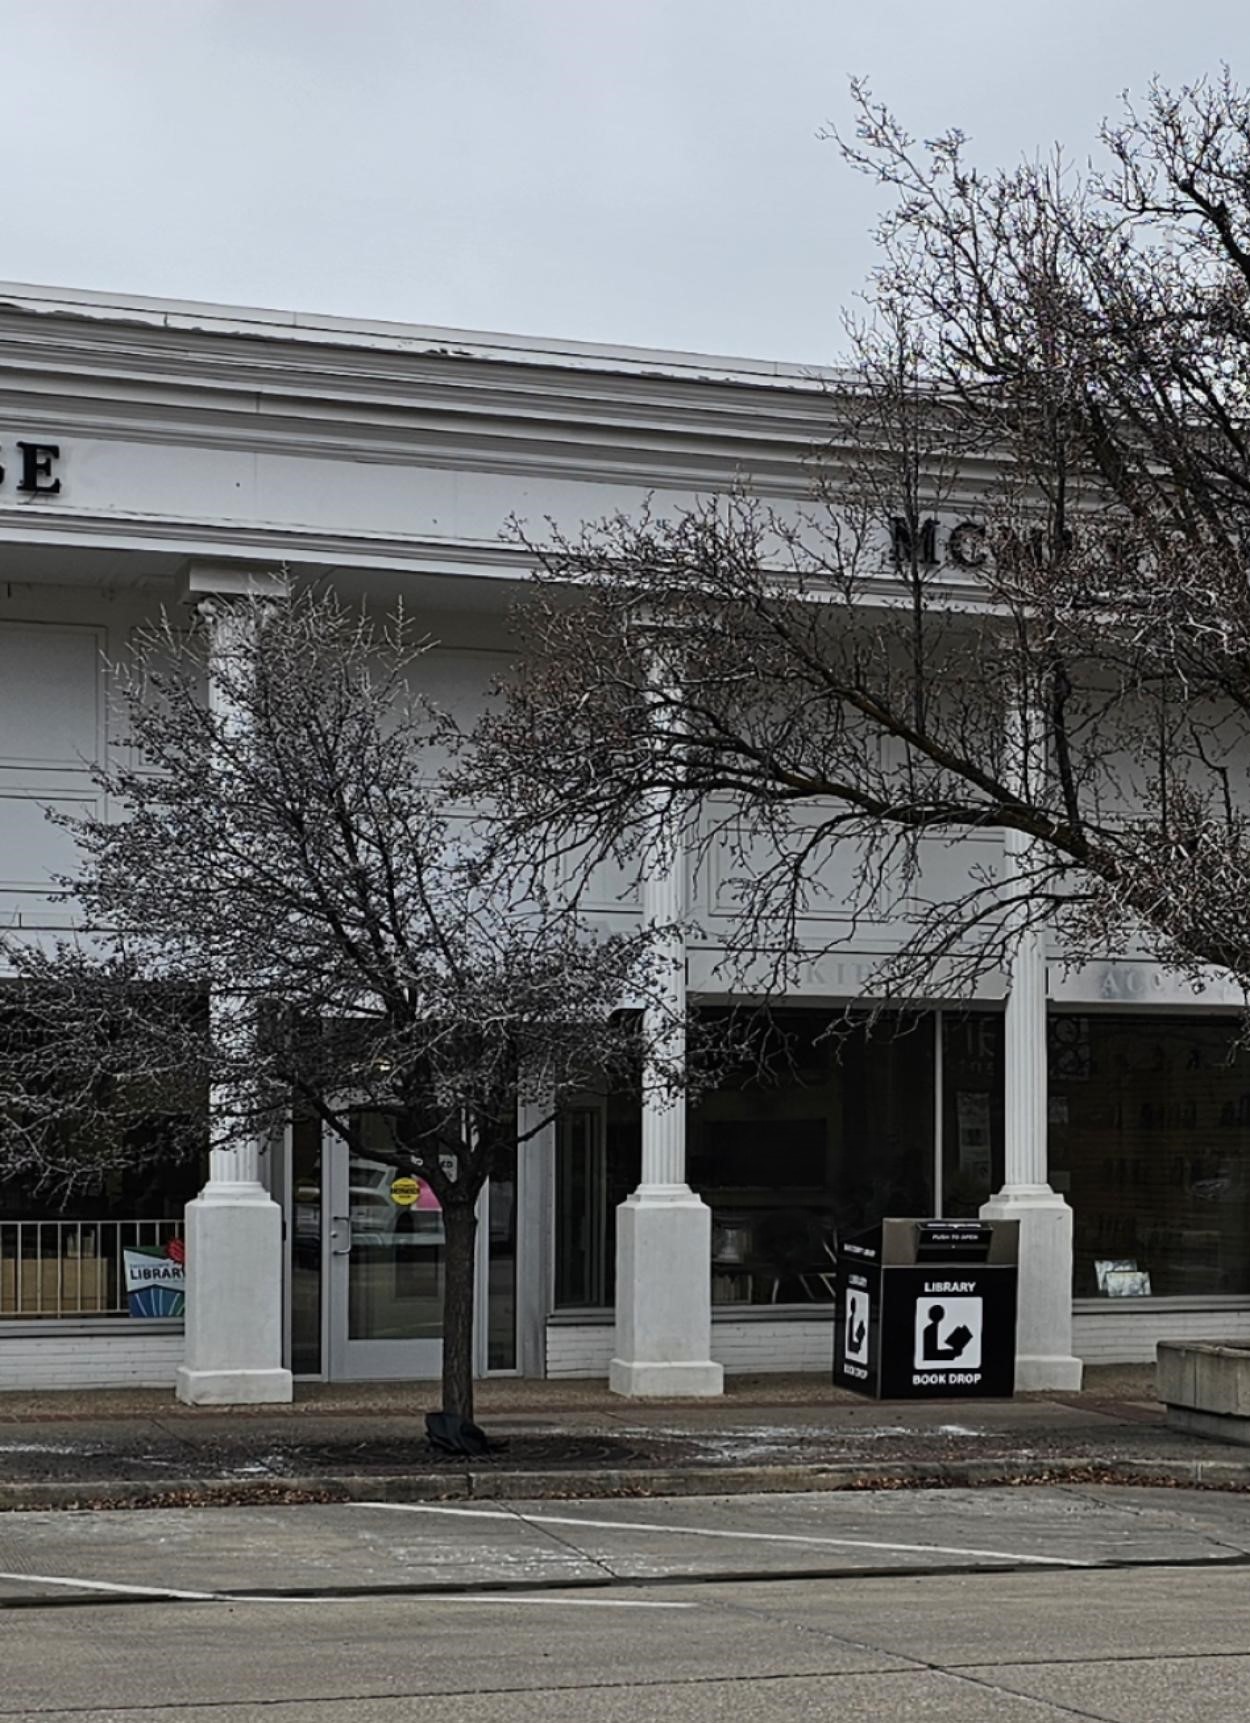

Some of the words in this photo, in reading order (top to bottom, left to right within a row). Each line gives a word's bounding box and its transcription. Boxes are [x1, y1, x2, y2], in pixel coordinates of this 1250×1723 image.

[0, 440, 62, 494] E
[924, 1281, 976, 1293] LIBRARY
[912, 1374, 946, 1385] BOOK
[949, 1373, 982, 1384] DROP
